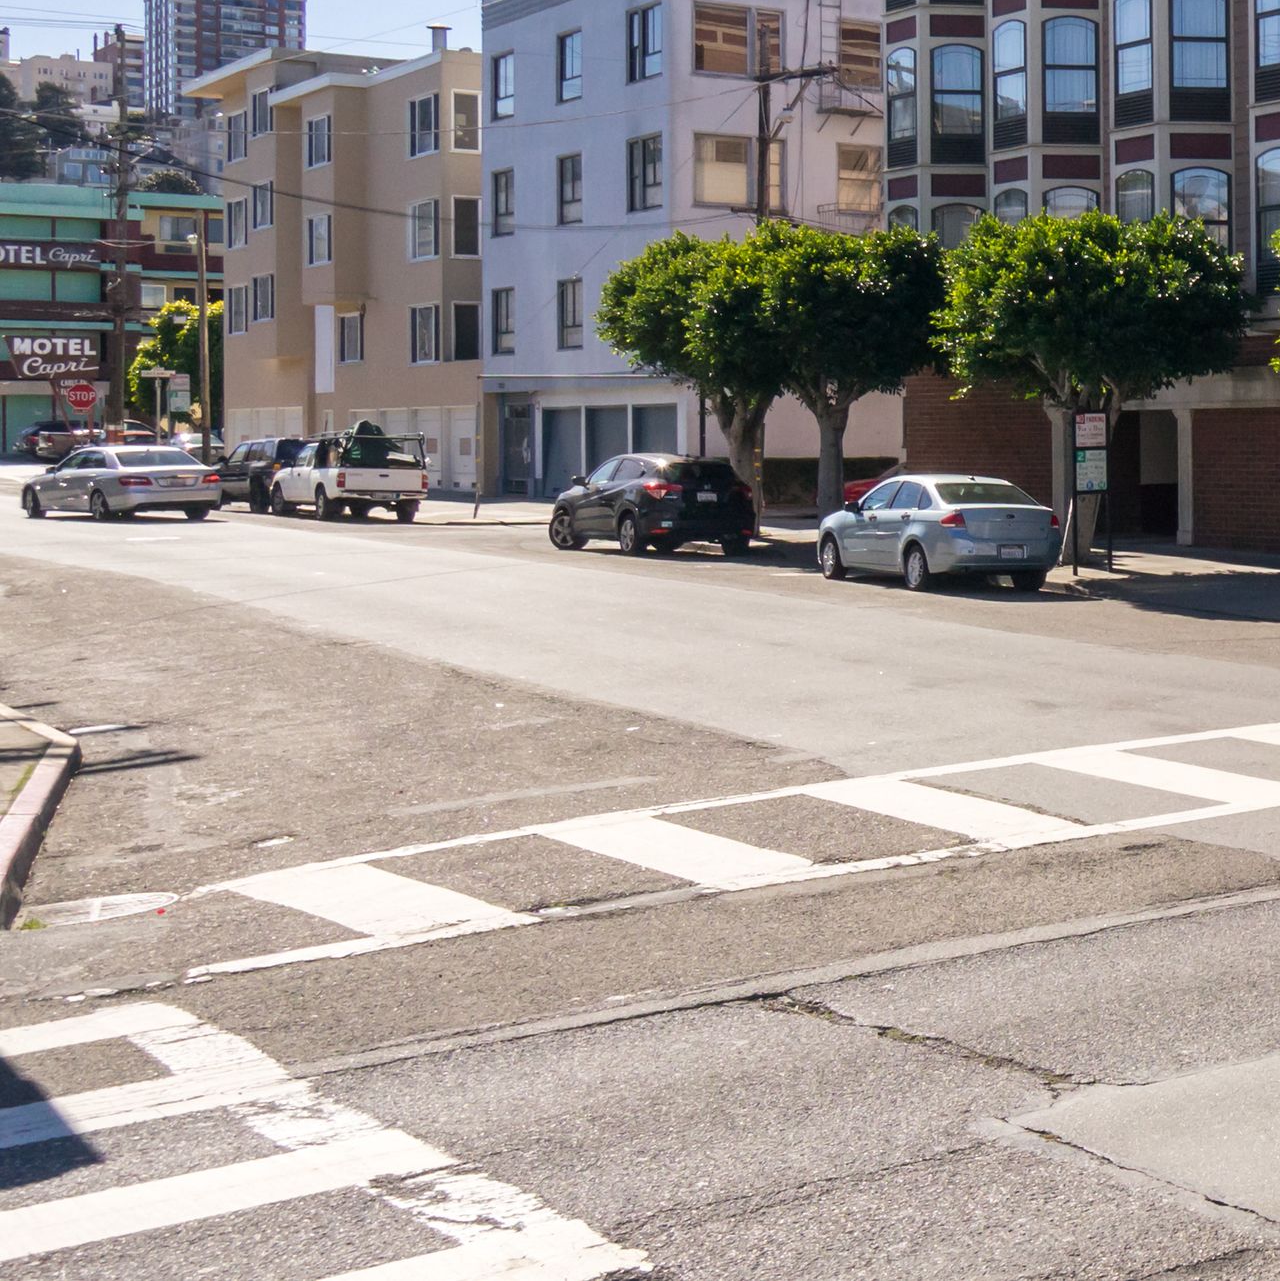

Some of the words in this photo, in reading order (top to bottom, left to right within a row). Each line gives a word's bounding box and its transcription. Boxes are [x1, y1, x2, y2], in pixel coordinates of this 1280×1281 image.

[49, 247, 100, 269] Capri
[14, 337, 97, 356] MOTEL
[23, 357, 99, 379] Capri
[69, 391, 95, 401] STOP
